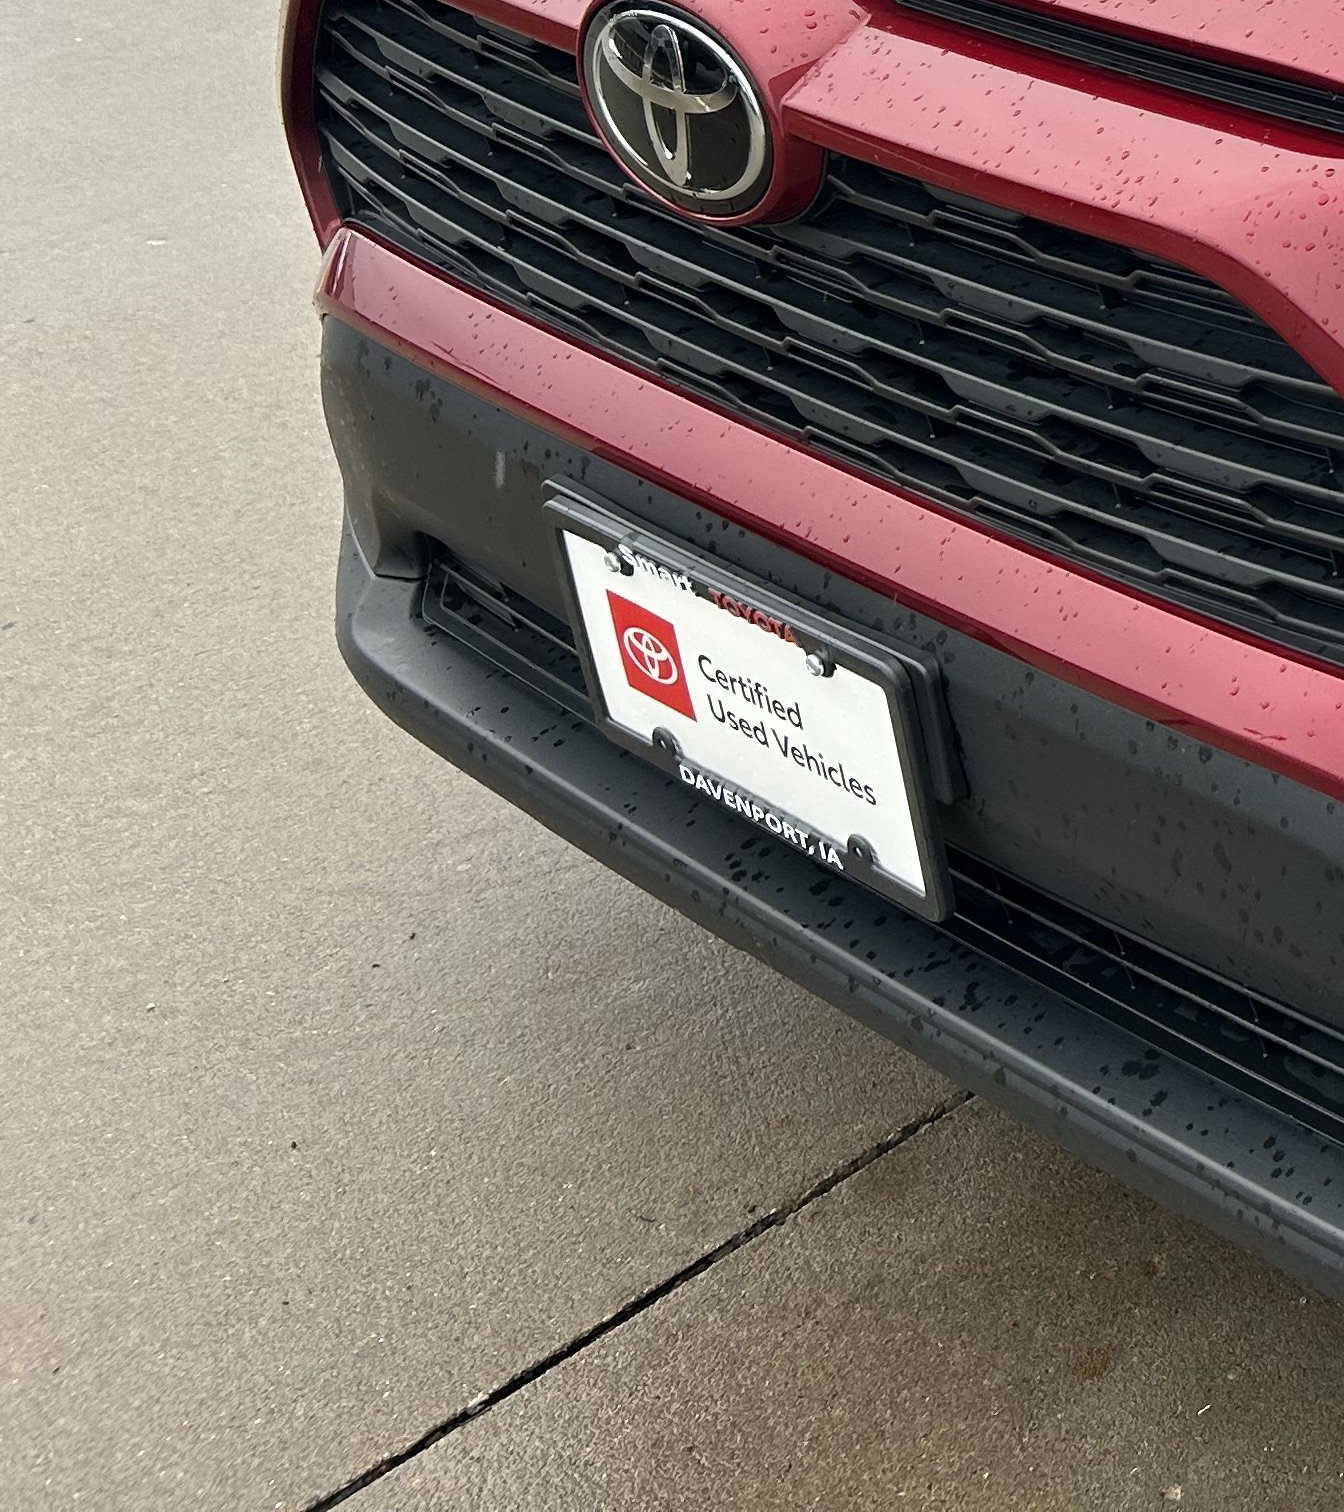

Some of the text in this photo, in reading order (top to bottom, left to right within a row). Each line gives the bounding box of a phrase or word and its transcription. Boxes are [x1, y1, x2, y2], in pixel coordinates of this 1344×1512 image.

[618, 543, 800, 648] Smart TOYOTA
[698, 654, 803, 730] Certified
[707, 693, 877, 805] Used Vehicles
[679, 764, 844, 870] DAVENPORT, IA
